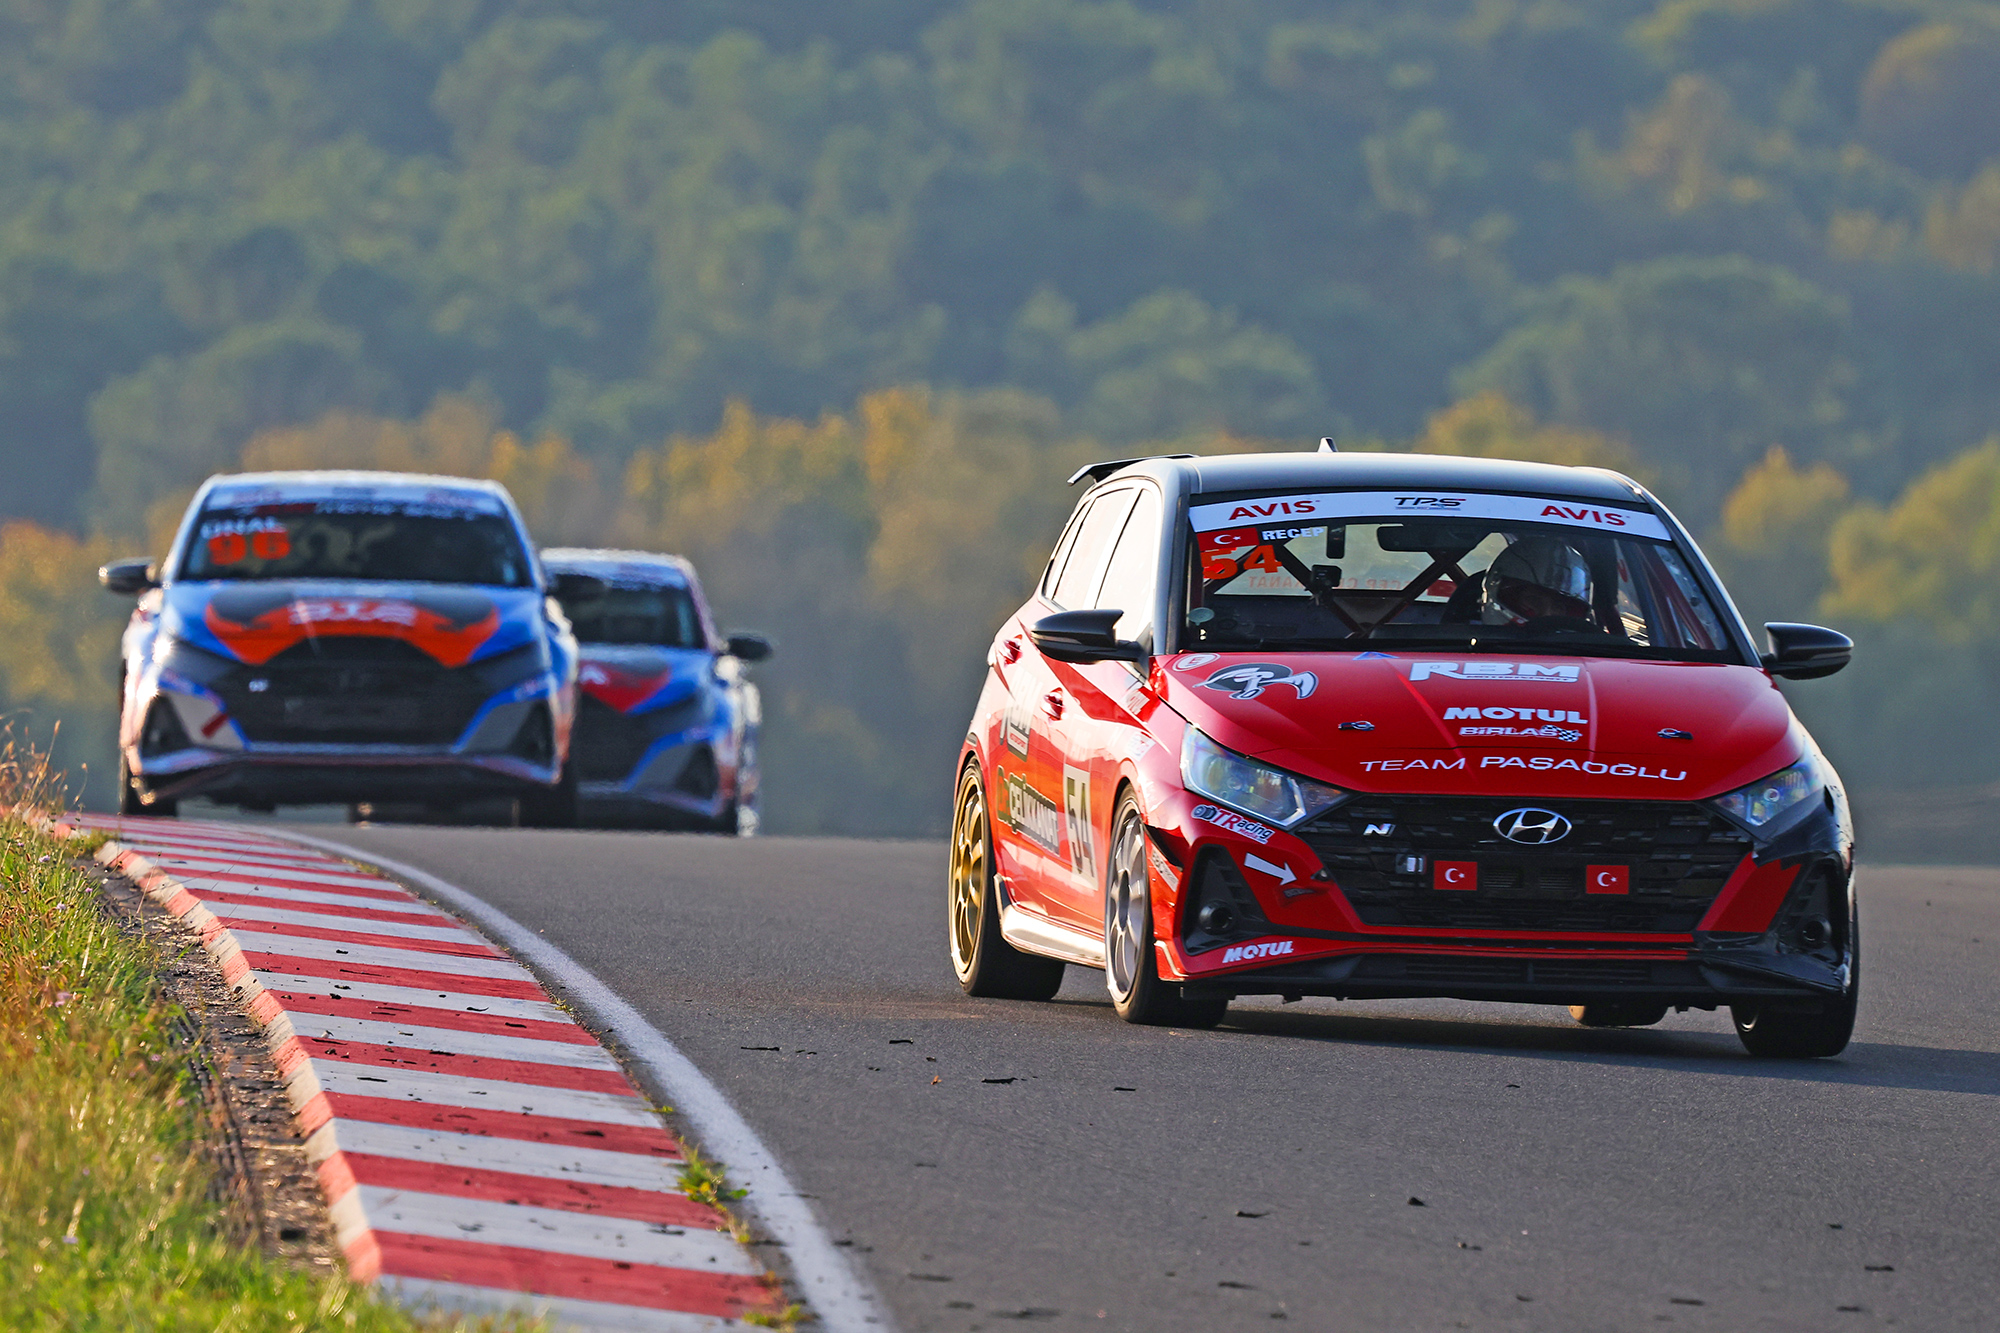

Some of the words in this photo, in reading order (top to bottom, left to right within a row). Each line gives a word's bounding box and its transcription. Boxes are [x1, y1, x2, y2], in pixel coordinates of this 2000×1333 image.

[1228, 500, 1316, 521] AVIS
[1394, 497, 1466, 506] TPS
[1541, 505, 1626, 526] AVIS
[1261, 527, 1325, 541] RECEP
[1200, 544, 1283, 580] 54
[1409, 662, 1580, 683] RBM
[1443, 706, 1588, 724] MOTUL
[1360, 757, 1466, 772] TEAM
[1067, 776, 1095, 878] 54
[1222, 941, 1294, 963] MOTUL
